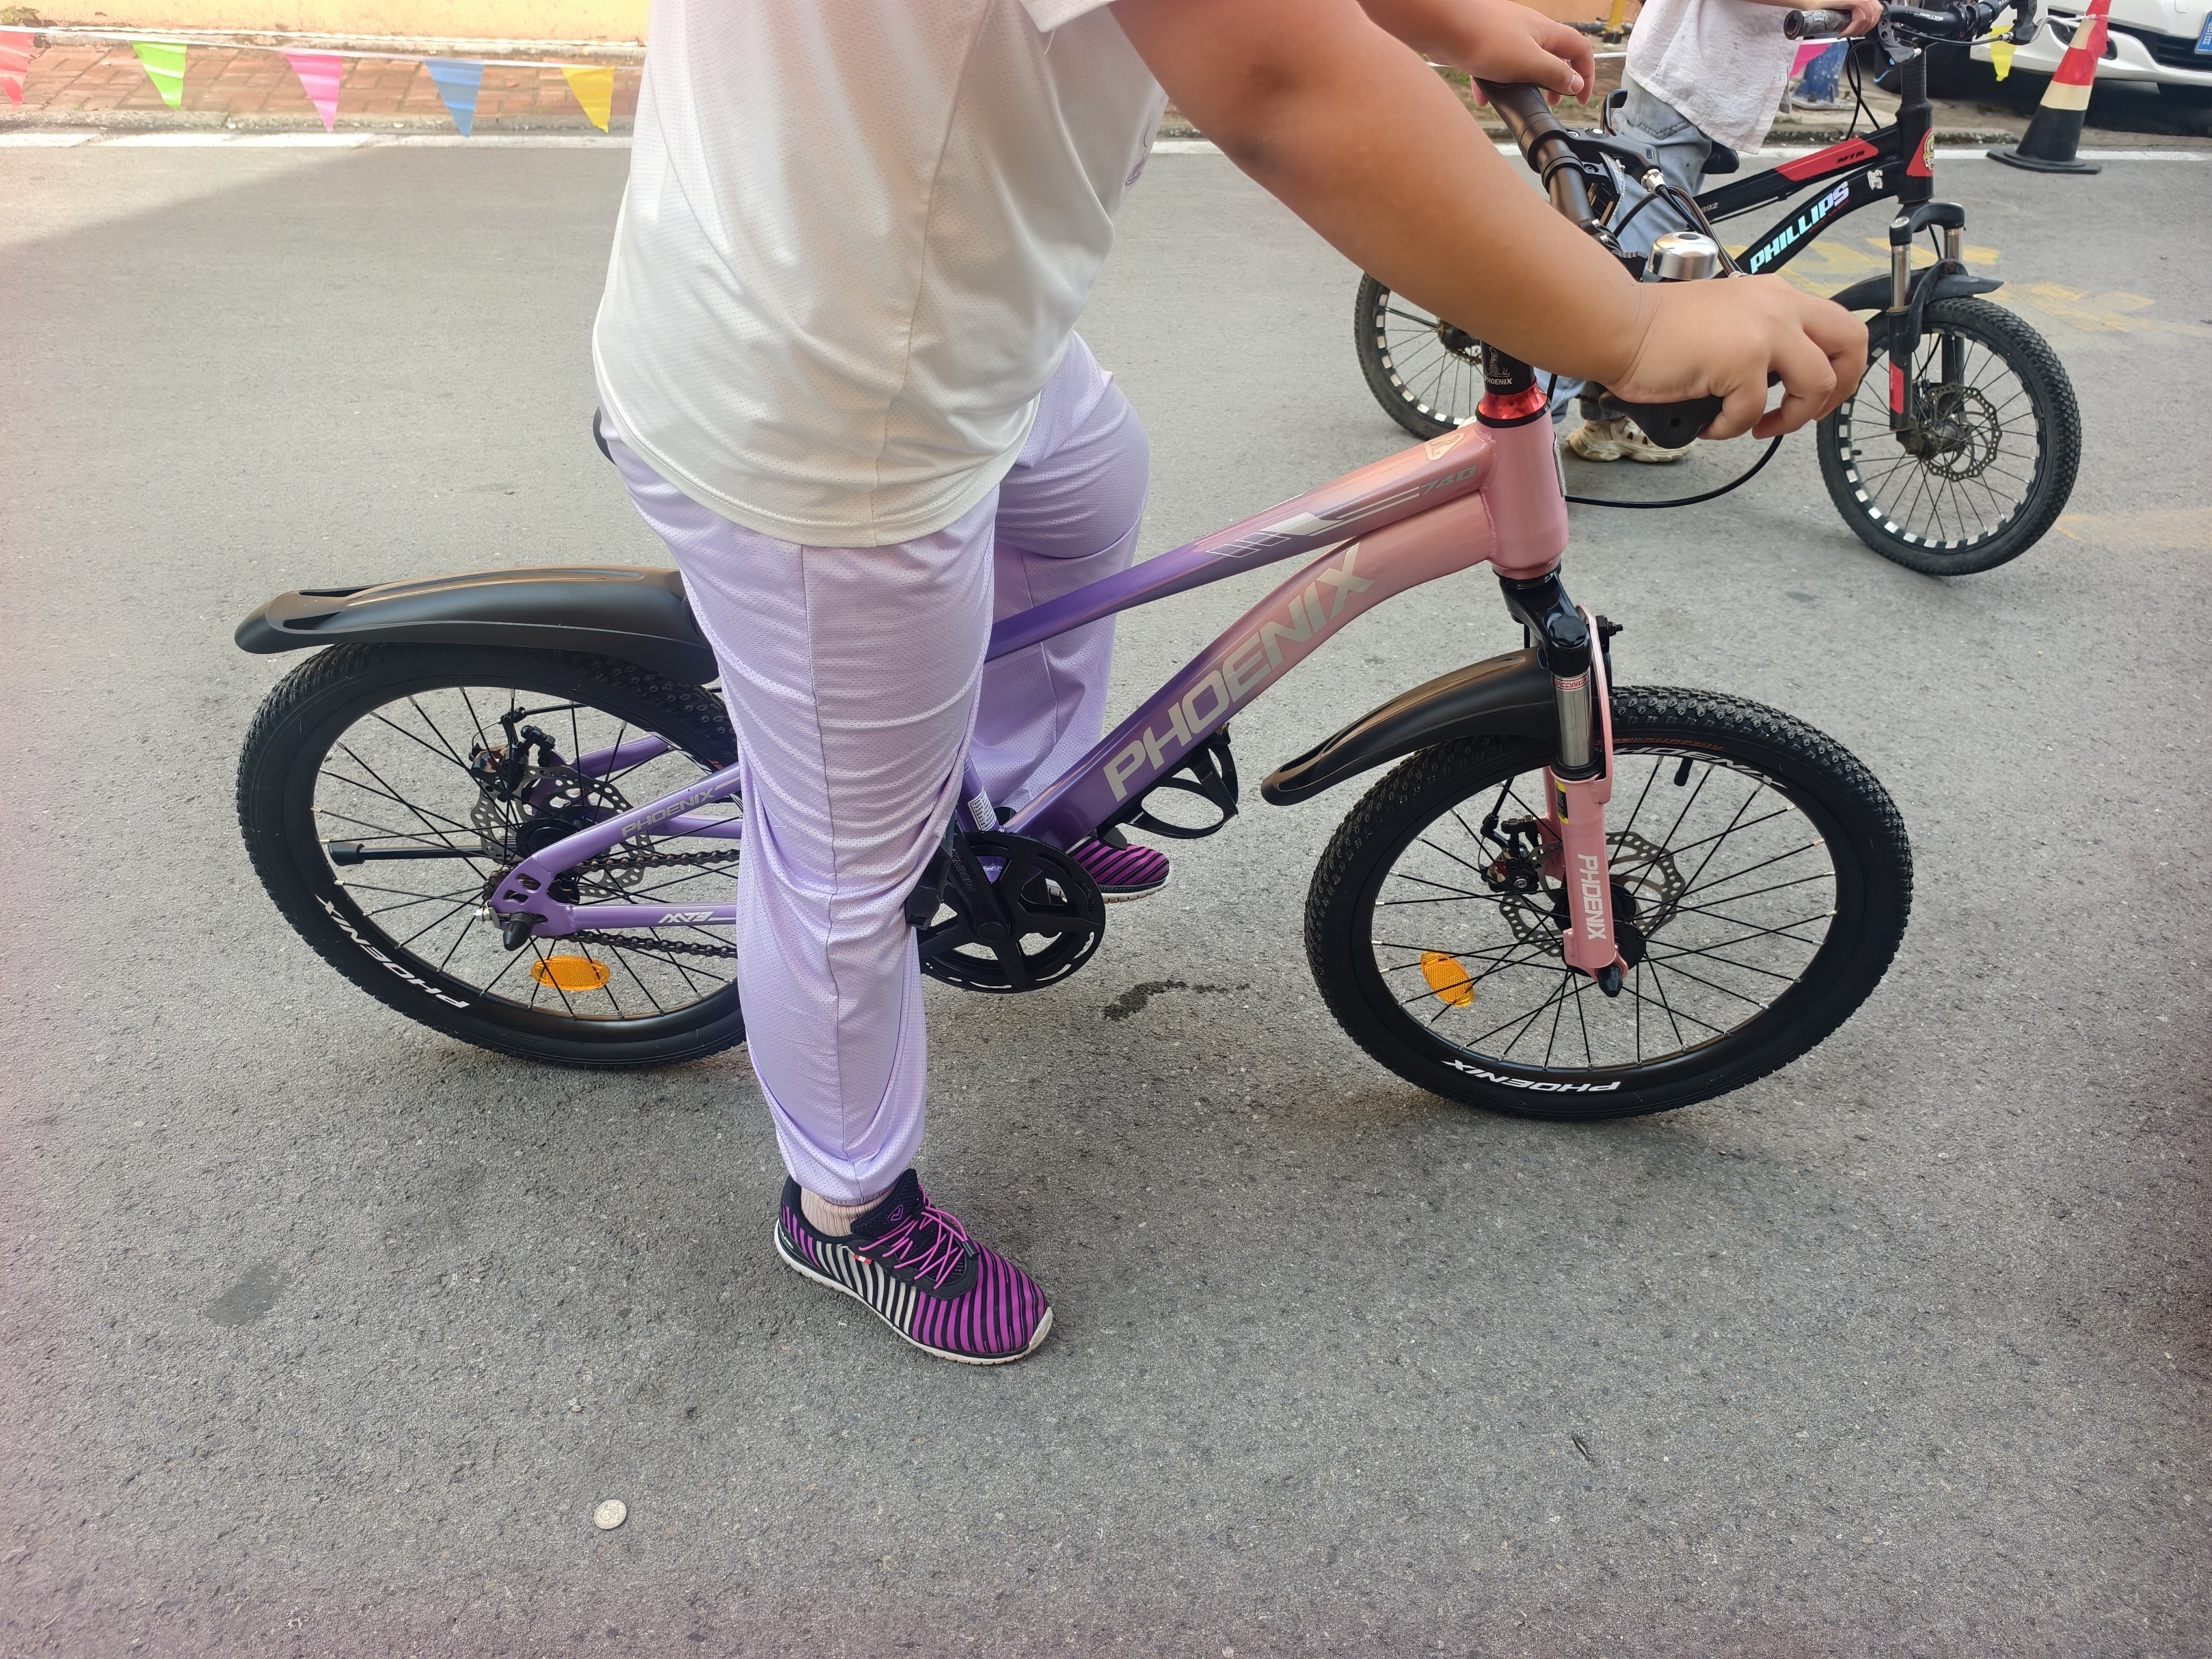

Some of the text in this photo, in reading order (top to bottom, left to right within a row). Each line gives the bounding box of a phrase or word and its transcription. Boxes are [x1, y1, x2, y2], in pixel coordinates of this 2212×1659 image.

[1750, 181, 1849, 274] PHILLIPS
[1483, 375, 1513, 385] PHOENIX
[1419, 466, 1477, 496] 740
[1103, 543, 1375, 802] PHOENIX
[1613, 747, 1788, 789] HOENIX
[622, 787, 714, 837] PHOENIX
[1577, 854, 1607, 940] PHOENIX
[314, 893, 470, 1008] PHOENIX
[1440, 1059, 1621, 1092] PHOENIX
